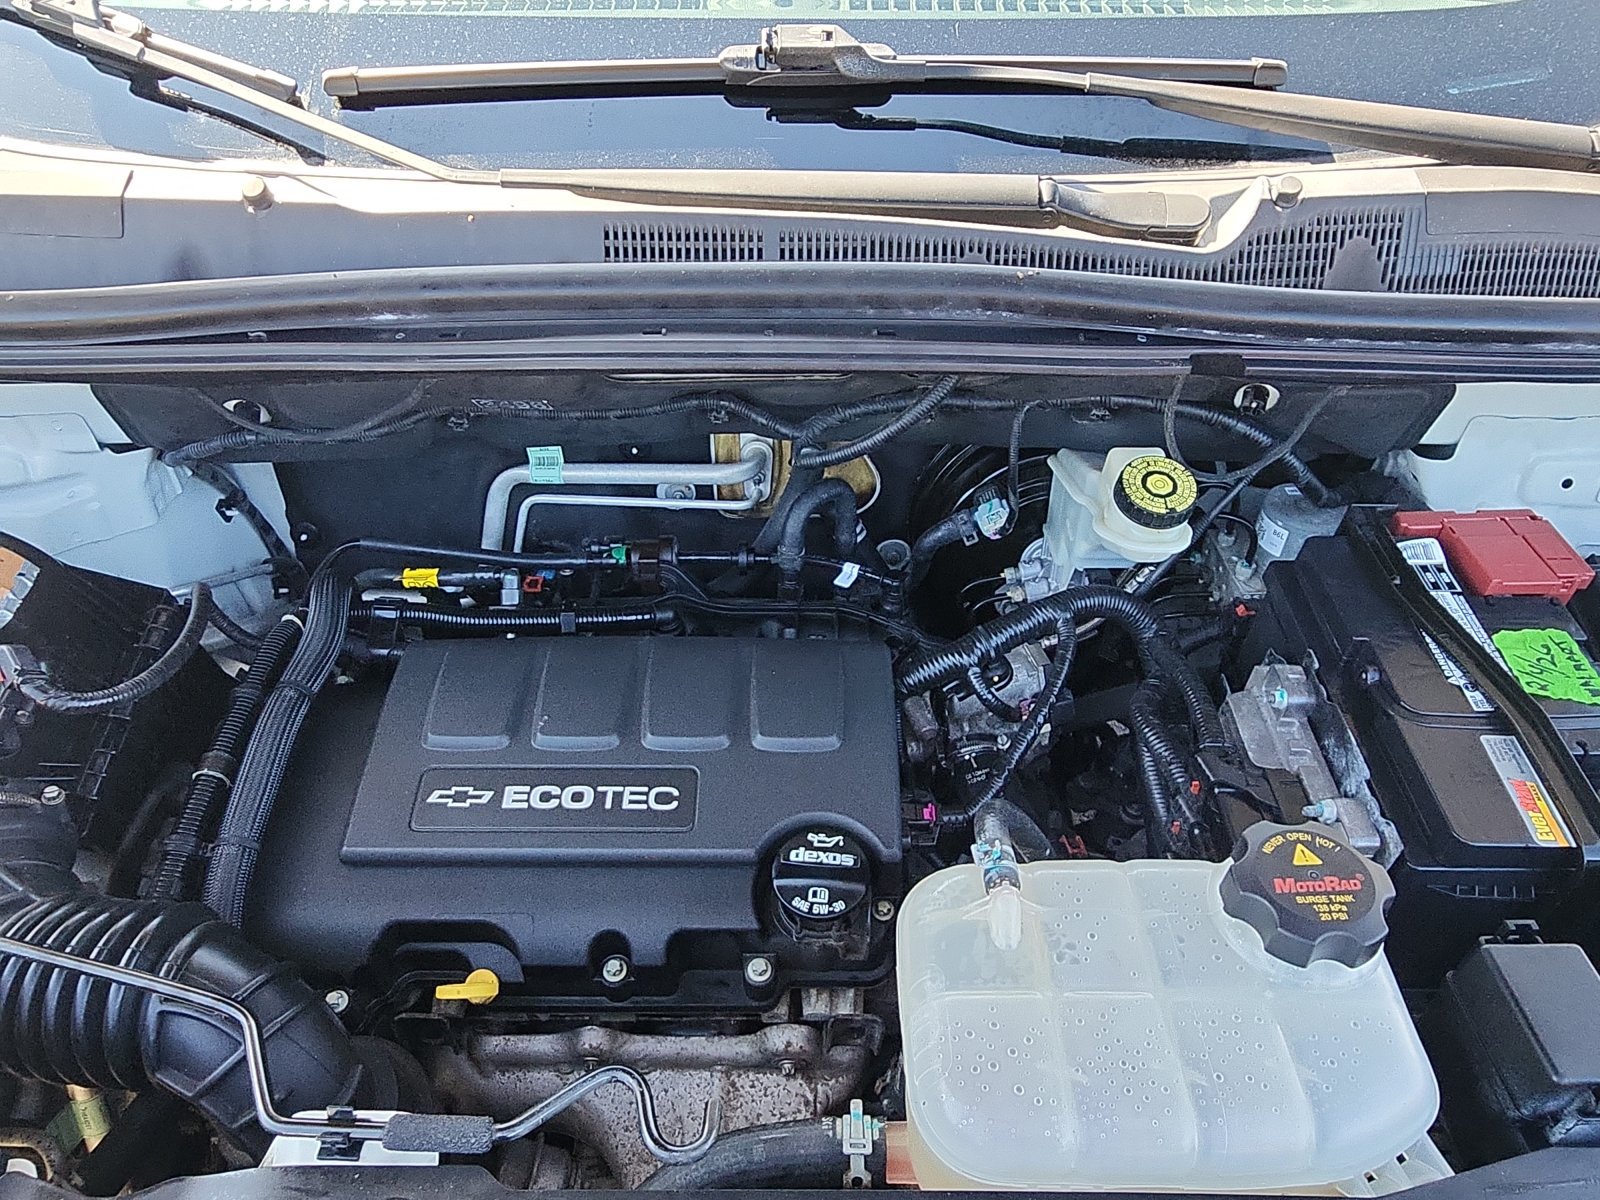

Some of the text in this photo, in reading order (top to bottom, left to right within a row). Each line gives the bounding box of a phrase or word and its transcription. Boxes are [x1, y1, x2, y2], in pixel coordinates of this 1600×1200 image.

[501, 785, 680, 811] ECOTEC
[1506, 777, 1556, 841] EverStart
[1262, 835, 1286, 855] NEVER
[1286, 832, 1312, 841] OPEN
[789, 847, 855, 866] dexos
[792, 896, 846, 915] SAE 5W-30
[1295, 894, 1356, 904] SURGE TANK
[1330, 903, 1348, 912] kPa
[1319, 912, 1349, 921] 20 PSI
